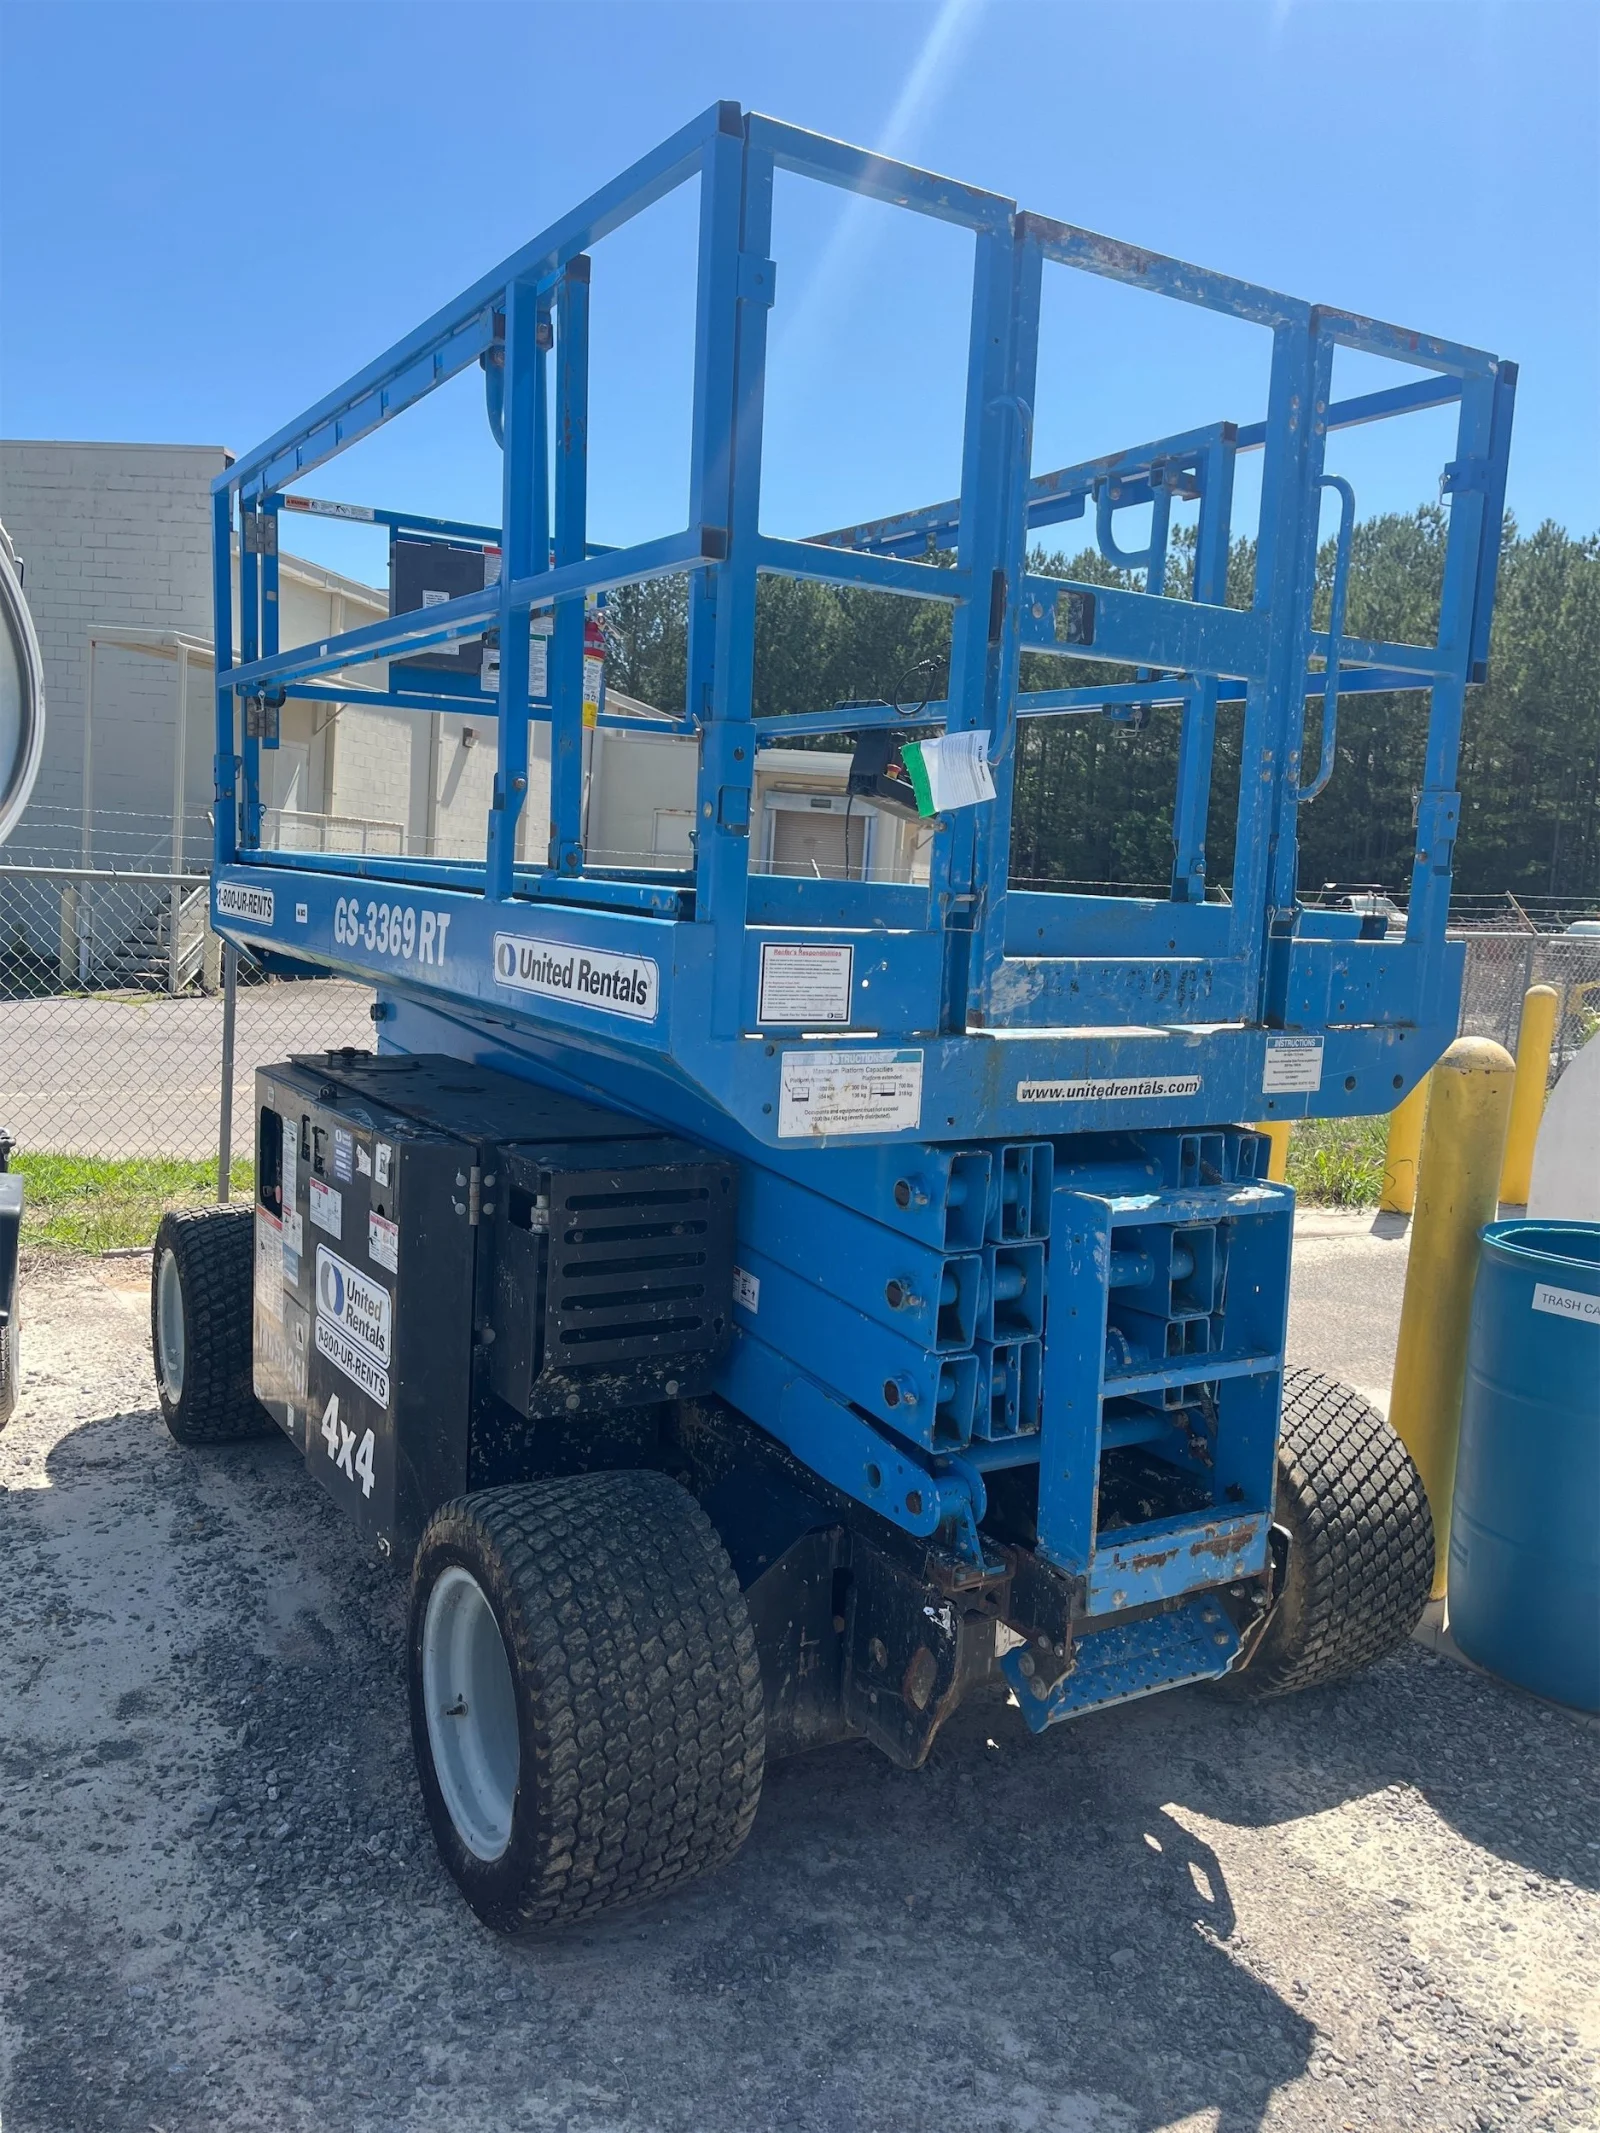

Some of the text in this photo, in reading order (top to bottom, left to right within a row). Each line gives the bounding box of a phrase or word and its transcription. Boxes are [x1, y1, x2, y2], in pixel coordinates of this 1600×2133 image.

[217, 888, 273, 918] 1-800-UR-RENTS
[334, 896, 451, 967] GS-3369 RT
[519, 948, 648, 1006] United Rentals
[1274, 1038, 1316, 1048] INSTRUCTIONS
[841, 1066, 865, 1074] Platform
[865, 1066, 894, 1075] Capacities
[1021, 1080, 1198, 1099] www.unitedrentals.com
[346, 1277, 383, 1323] United
[1542, 1292, 1581, 1312] TRASH
[345, 1303, 386, 1352] Rentals
[317, 1325, 386, 1398] 1-800-UR-RENTS
[321, 1392, 375, 1500] 4x4
